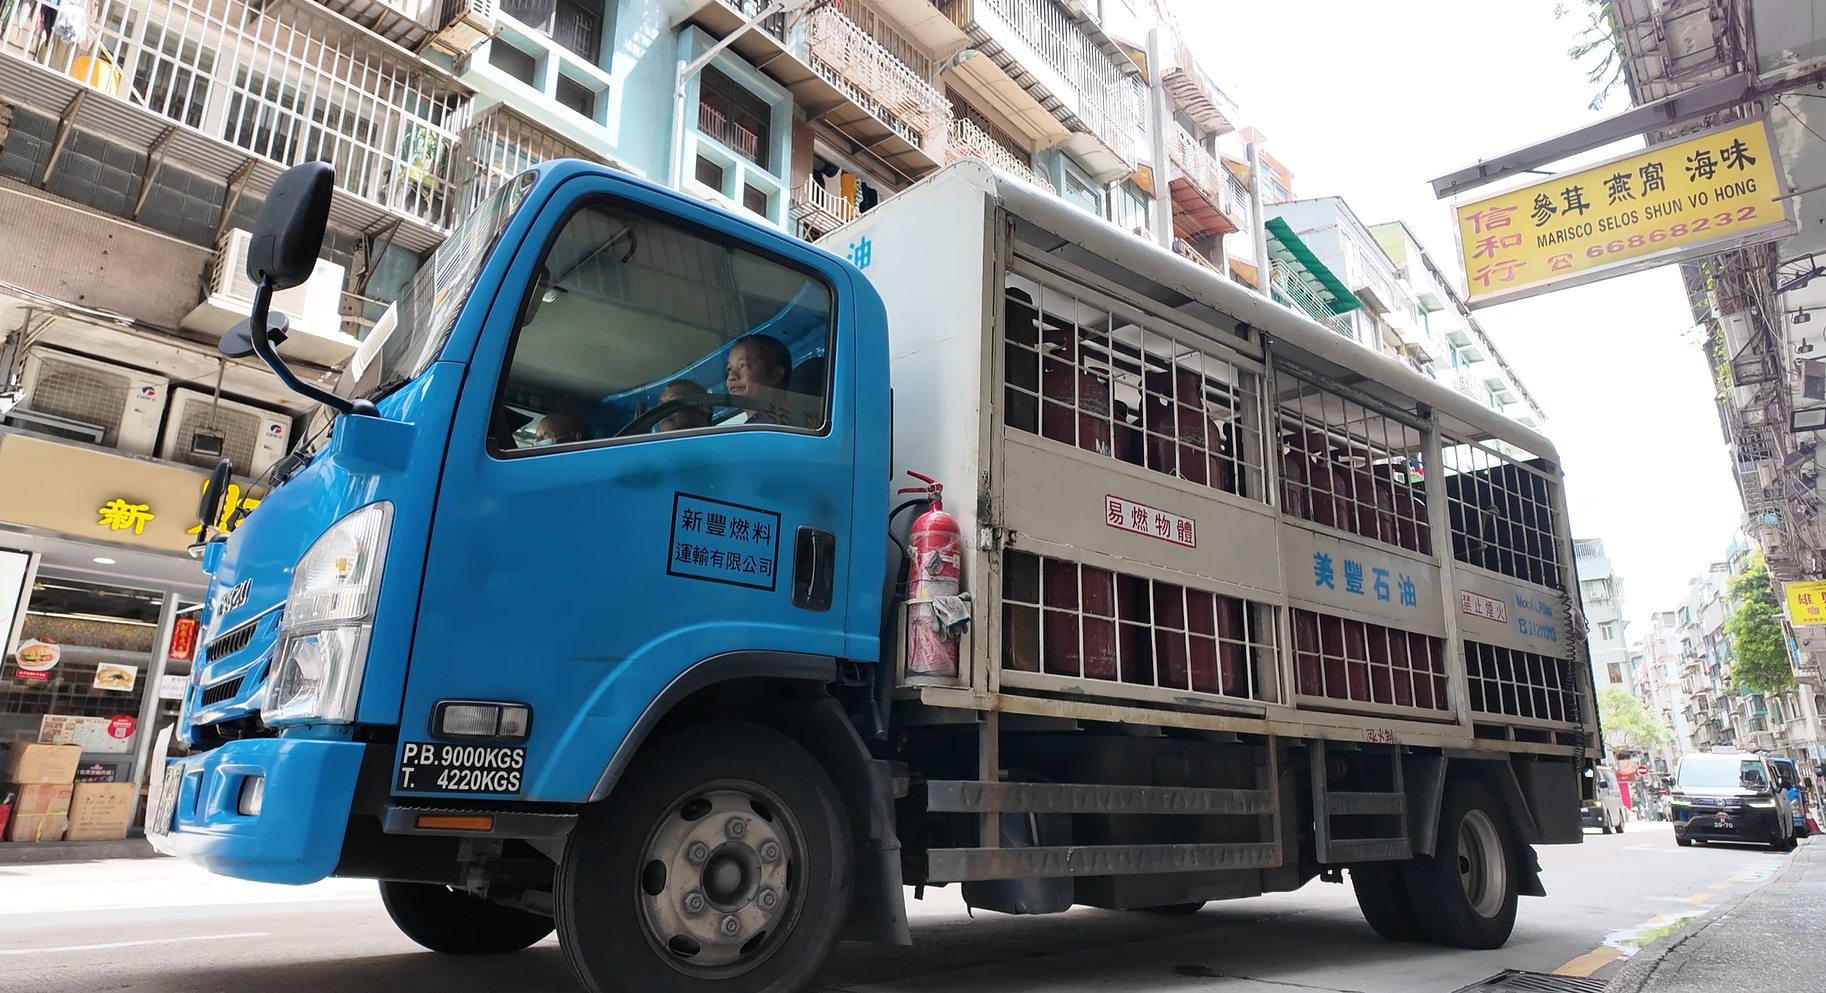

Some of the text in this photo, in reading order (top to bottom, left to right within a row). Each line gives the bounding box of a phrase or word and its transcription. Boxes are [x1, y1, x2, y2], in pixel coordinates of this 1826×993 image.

[1685, 138, 1756, 182] 海味
[1536, 178, 1757, 248] MARISCO SELOS SHUN VO HONG
[1586, 206, 1758, 259] 66868232
[1464, 205, 1527, 287] 信和行
[98, 498, 155, 535] 新
[681, 508, 771, 546] 新豐燃料
[1107, 501, 1193, 545] 易燃物體
[675, 542, 772, 577] 運輸有限公司
[1313, 551, 1417, 608] 美豐石油
[1462, 594, 1505, 620] 禁止煙火
[402, 767, 520, 792] T. 4220KGS
